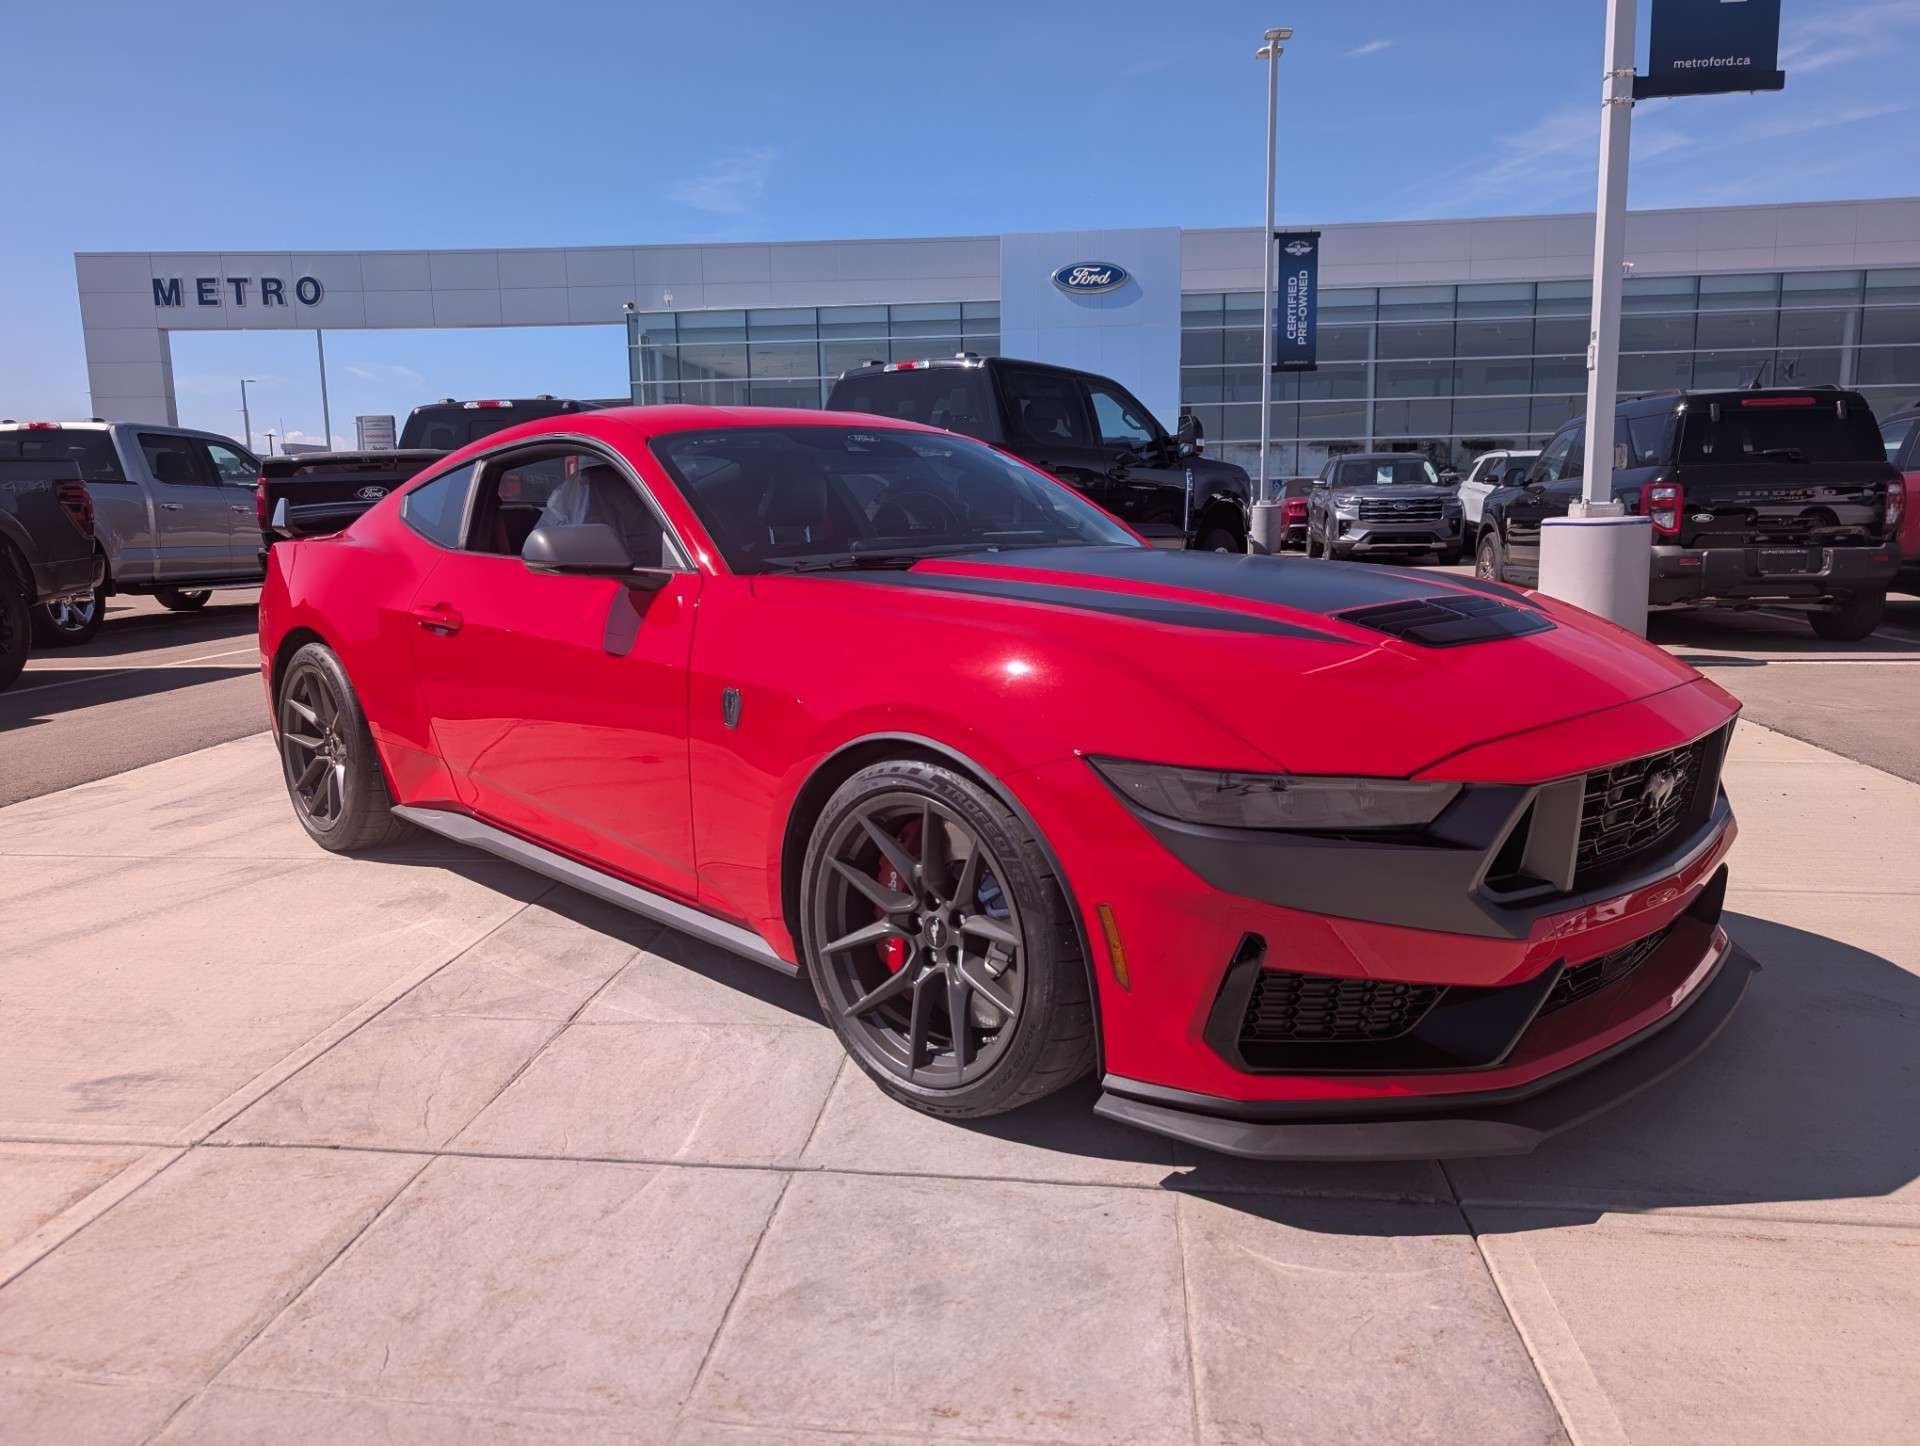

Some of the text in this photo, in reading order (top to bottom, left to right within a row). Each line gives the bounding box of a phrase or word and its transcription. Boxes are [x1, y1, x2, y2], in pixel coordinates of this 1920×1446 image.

[1673, 55, 1751, 69] metroford.ca
[152, 276, 322, 306] METRO
[1068, 267, 1112, 285] Ford
[1287, 276, 1297, 340] CERTIFIED
[1298, 270, 1308, 345] PRE-OWNED
